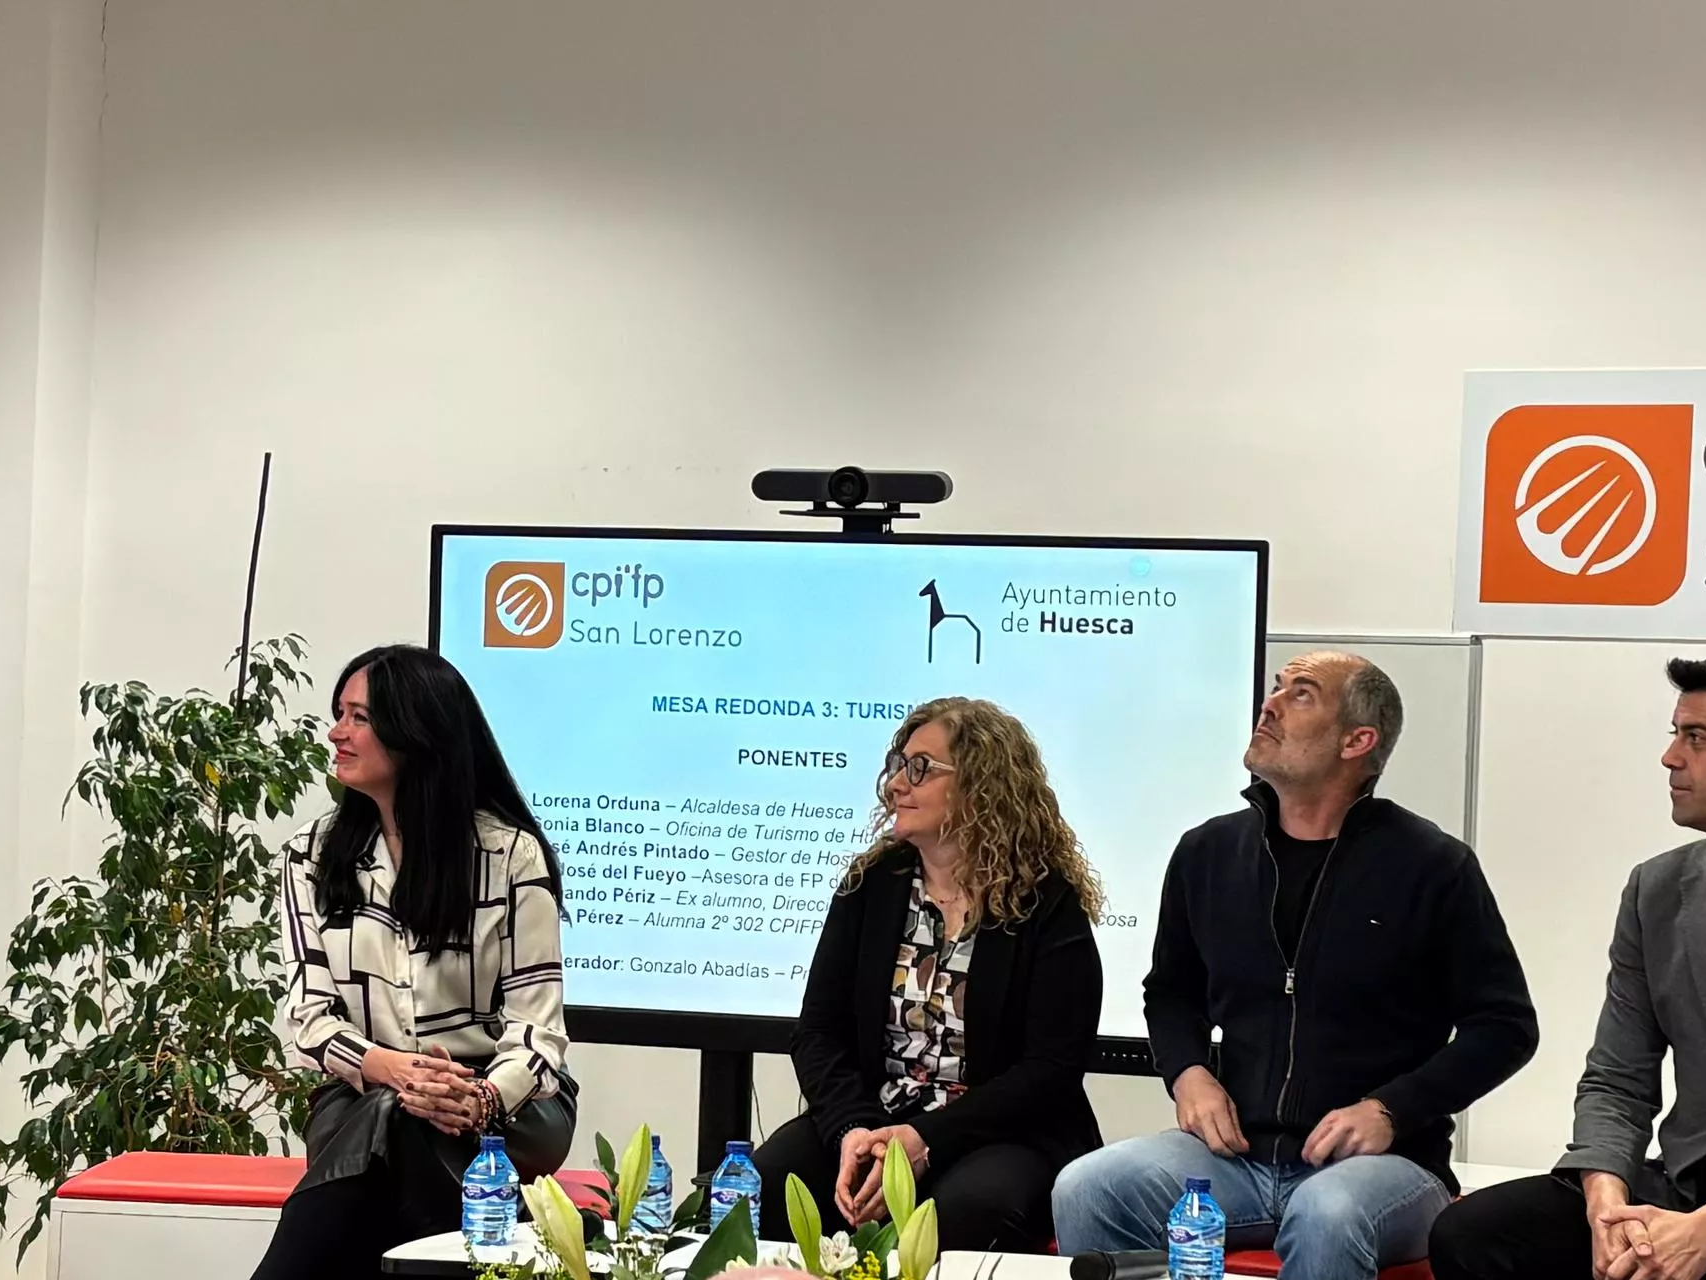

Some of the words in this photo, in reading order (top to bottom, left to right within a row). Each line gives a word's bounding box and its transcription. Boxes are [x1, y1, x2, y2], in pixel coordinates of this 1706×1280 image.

[1001, 581, 1177, 610] Ayuntamiento
[569, 618, 621, 645] San
[633, 620, 743, 648] Lorenzo
[1001, 611, 1030, 633] de
[1040, 611, 1134, 635] Huesca
[652, 695, 708, 714] MESA
[715, 698, 816, 718] REDONDA
[821, 701, 839, 718] 3:
[846, 701, 918, 721] TURIS
[738, 748, 848, 769] PONENTES
[532, 792, 591, 809] Lorena
[597, 794, 661, 812] Orduna
[680, 798, 760, 816] Alcaldesa
[765, 801, 786, 817] de
[791, 802, 854, 820] Huesca
[585, 817, 645, 835] Blanco
[666, 820, 722, 838] Oficina
[727, 823, 748, 839] de
[754, 824, 819, 842] Turismo
[824, 827, 845, 843] de
[552, 838, 571, 854] sé
[576, 840, 638, 858] Andrés
[643, 842, 710, 861] Pintado
[731, 846, 788, 863] Gestor
[790, 849, 812, 865] de
[602, 864, 628, 880] del
[634, 865, 687, 886] Fueyo
[774, 872, 795, 888] de
[800, 872, 824, 889] FP
[564, 886, 608, 902] ando
[613, 887, 656, 904] Périz
[676, 890, 698, 906] Ex
[702, 891, 767, 912] alumno,
[772, 894, 830, 912] Direcci
[576, 908, 624, 925] Pérez
[643, 911, 706, 930] Alumna
[733, 916, 765, 933] 302
[769, 917, 824, 935] CPIFP
[564, 955, 625, 971] erador:
[630, 956, 698, 975] Gonzalo
[701, 960, 770, 979] Abadías
